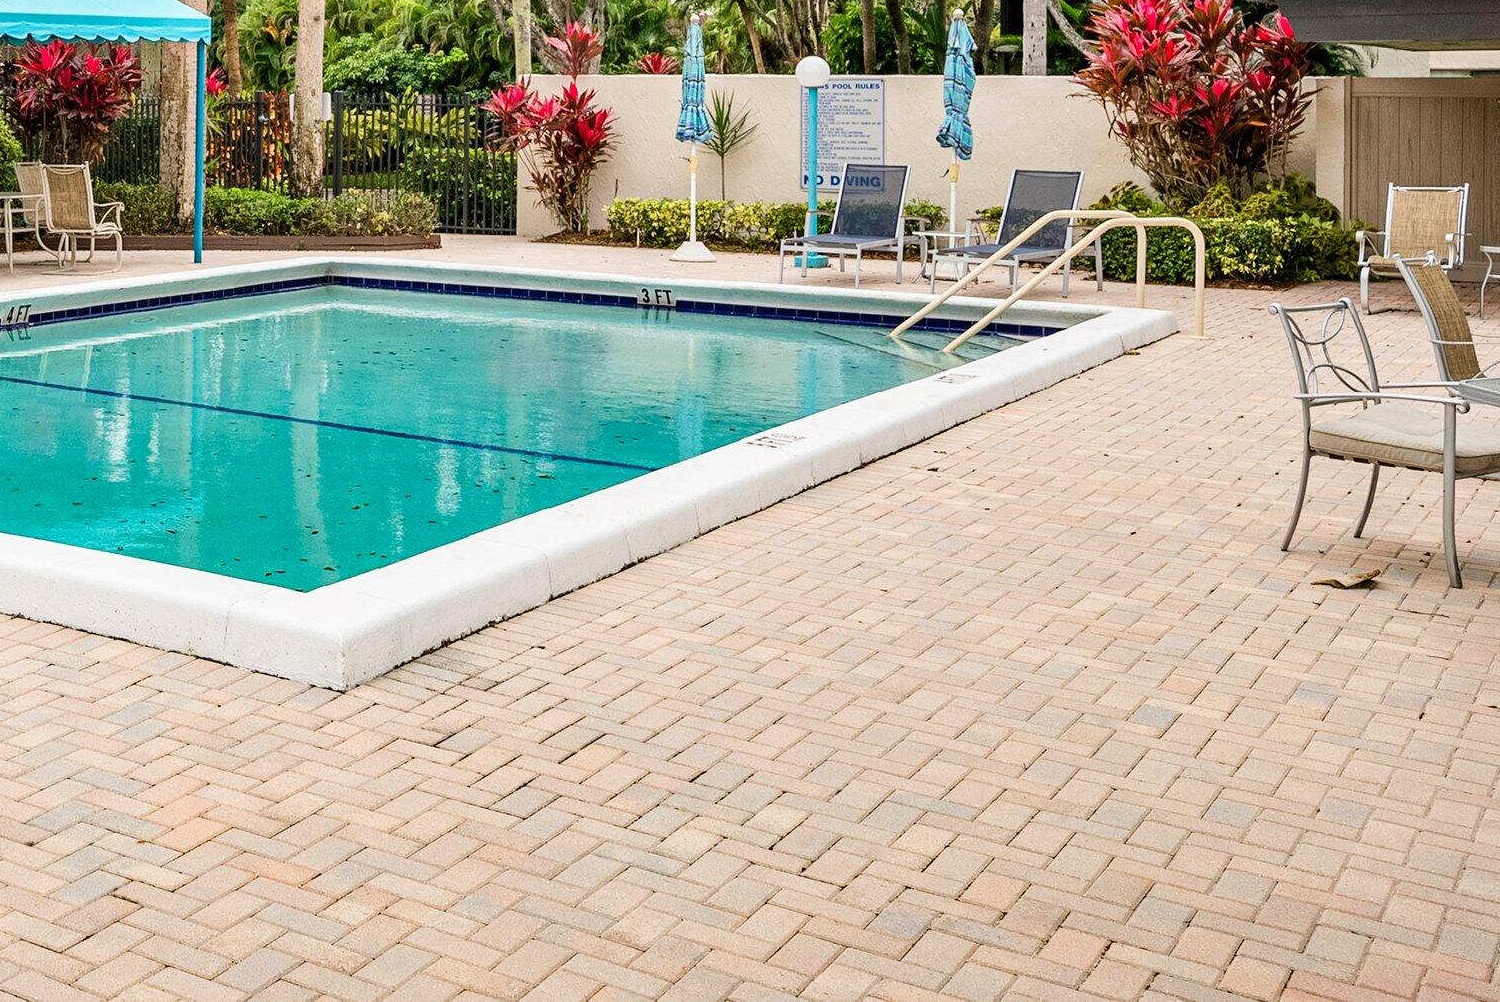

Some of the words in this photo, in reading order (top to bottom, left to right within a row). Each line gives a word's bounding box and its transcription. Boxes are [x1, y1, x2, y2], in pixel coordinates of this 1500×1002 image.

[830, 175, 881, 187] DVING
[641, 288, 650, 303] 3
[654, 289, 672, 304] FT
[6, 306, 15, 324] 4
[15, 304, 32, 323] FT
